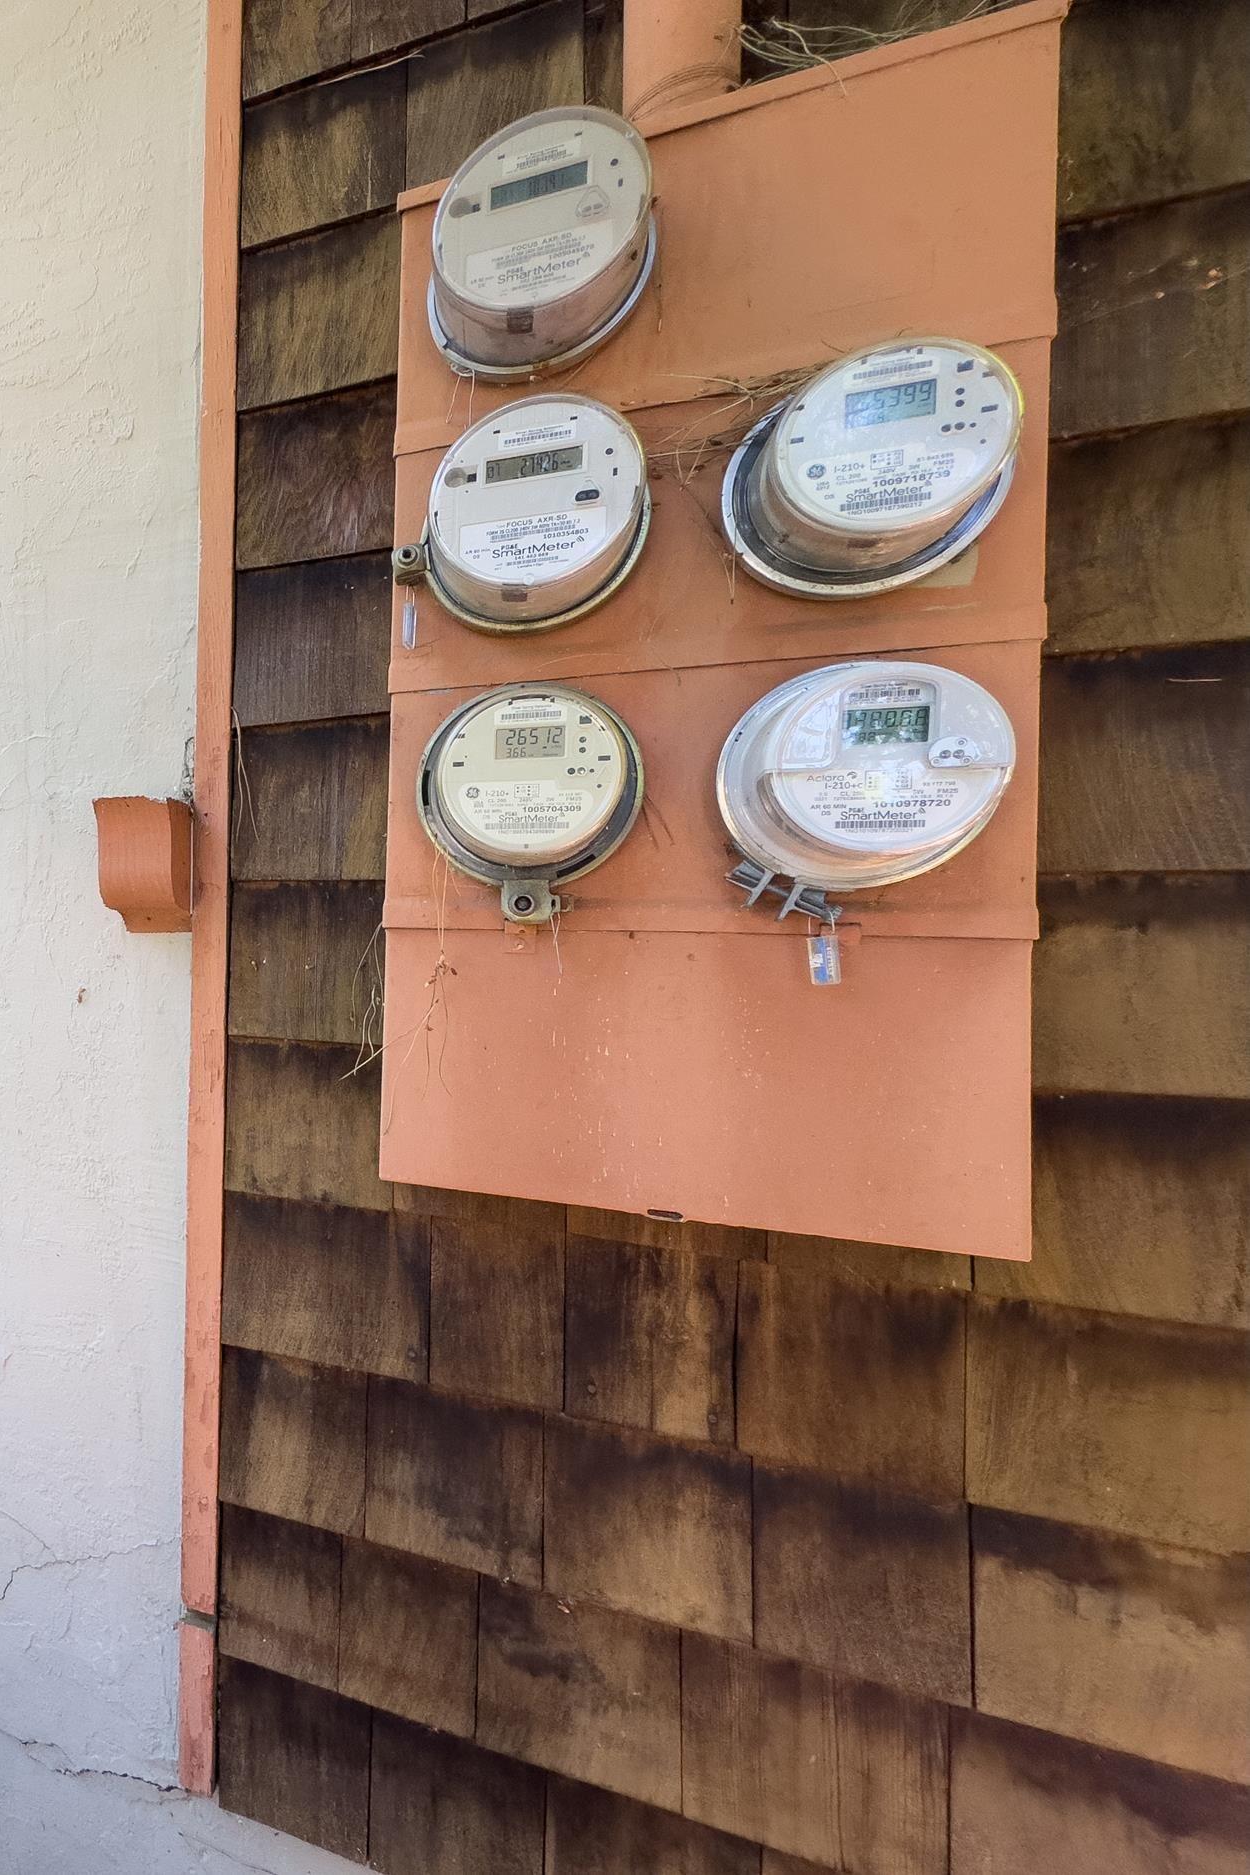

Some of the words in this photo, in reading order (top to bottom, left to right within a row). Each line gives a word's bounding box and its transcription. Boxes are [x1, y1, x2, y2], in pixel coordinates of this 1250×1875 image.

[497, 258, 581, 285] SmartMeter
[846, 485, 924, 503] SmartMeter
[506, 519, 533, 528] FOCUS
[492, 540, 576, 559] SmartMeter
[505, 728, 563, 746] 26512
[498, 815, 558, 823] SmartMeter
[840, 811, 917, 820] SmartMeter
